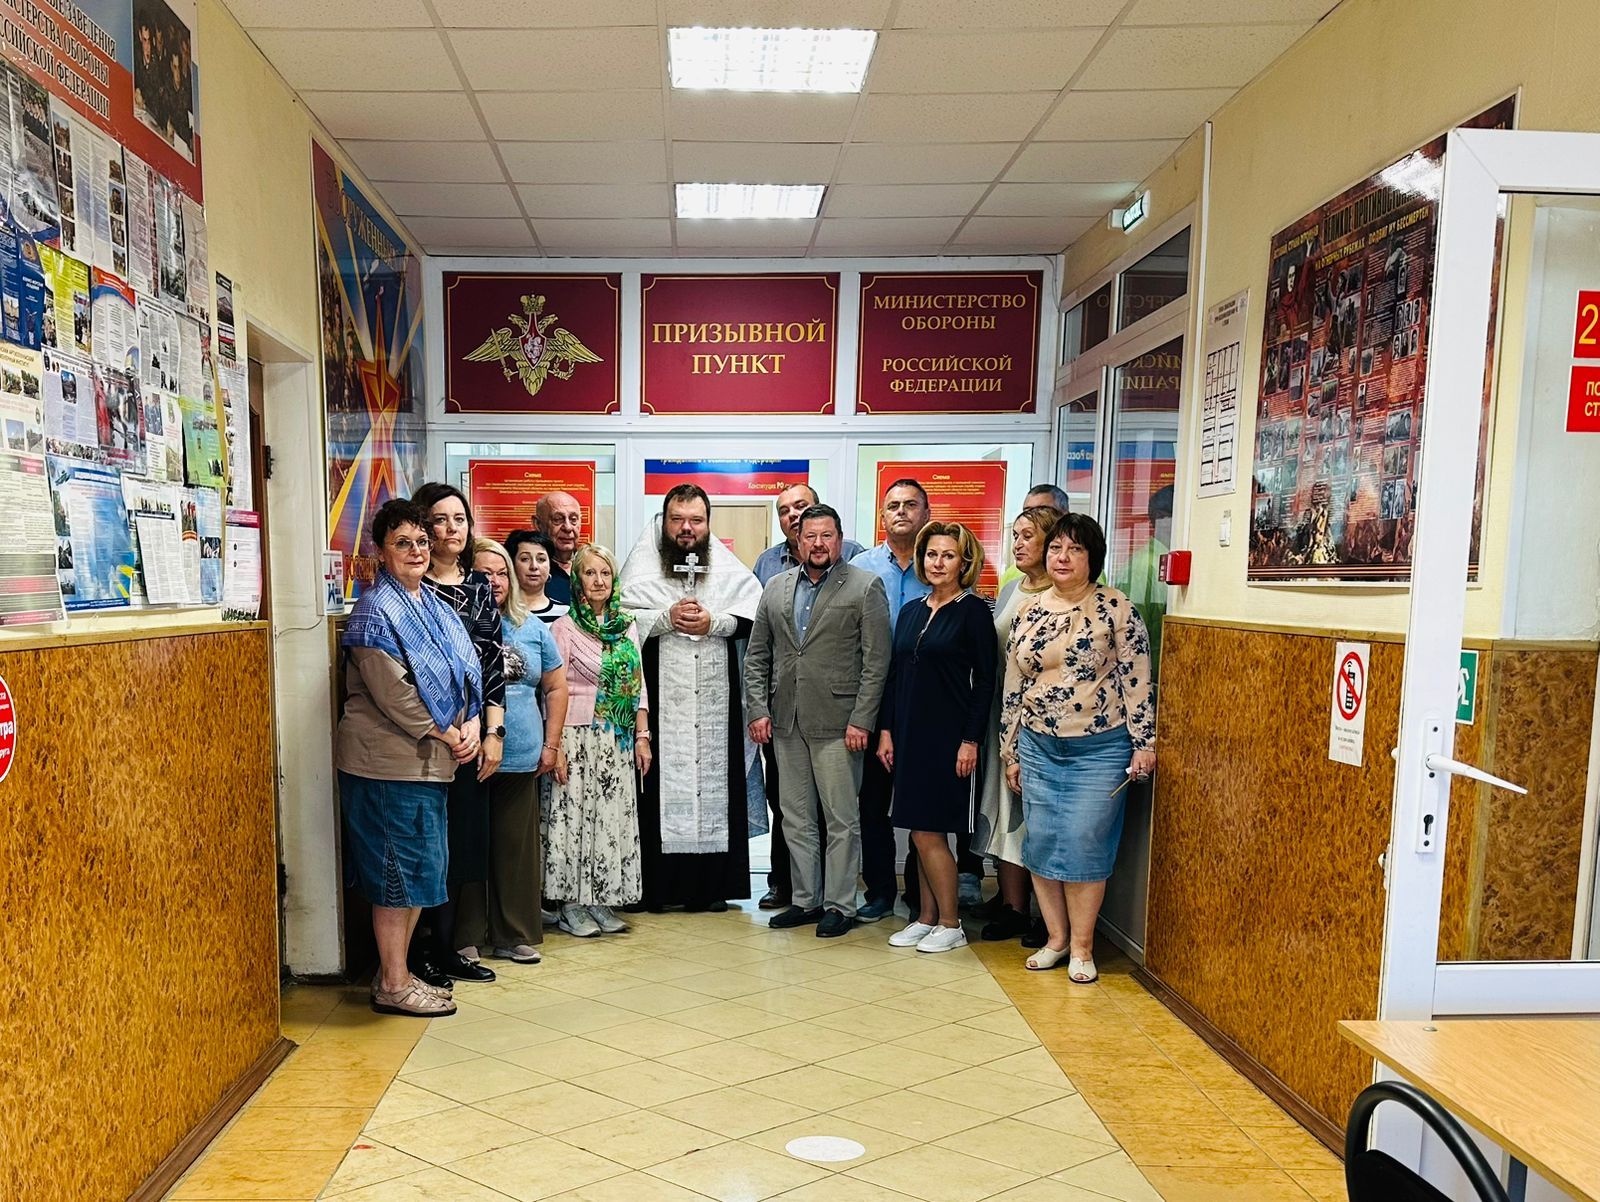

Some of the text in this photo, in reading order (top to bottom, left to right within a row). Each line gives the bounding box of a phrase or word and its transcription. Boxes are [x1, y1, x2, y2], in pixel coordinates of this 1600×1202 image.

[3, 0, 109, 88] СТЕРСТВА ОБОРОНЫ
[56, 59, 110, 121] ФЕДЕРАЦИИ
[873, 294, 1026, 309] МИНИСТЕРСТВО
[652, 318, 826, 343] ПРИЗЫВНОЙ
[902, 315, 996, 331] ОБОРОНЫ
[692, 354, 786, 374] ПУНКТ
[882, 354, 1013, 372] РОССИЙСКОЙ
[890, 378, 1002, 394] ФЕДЕРАЦИИ
